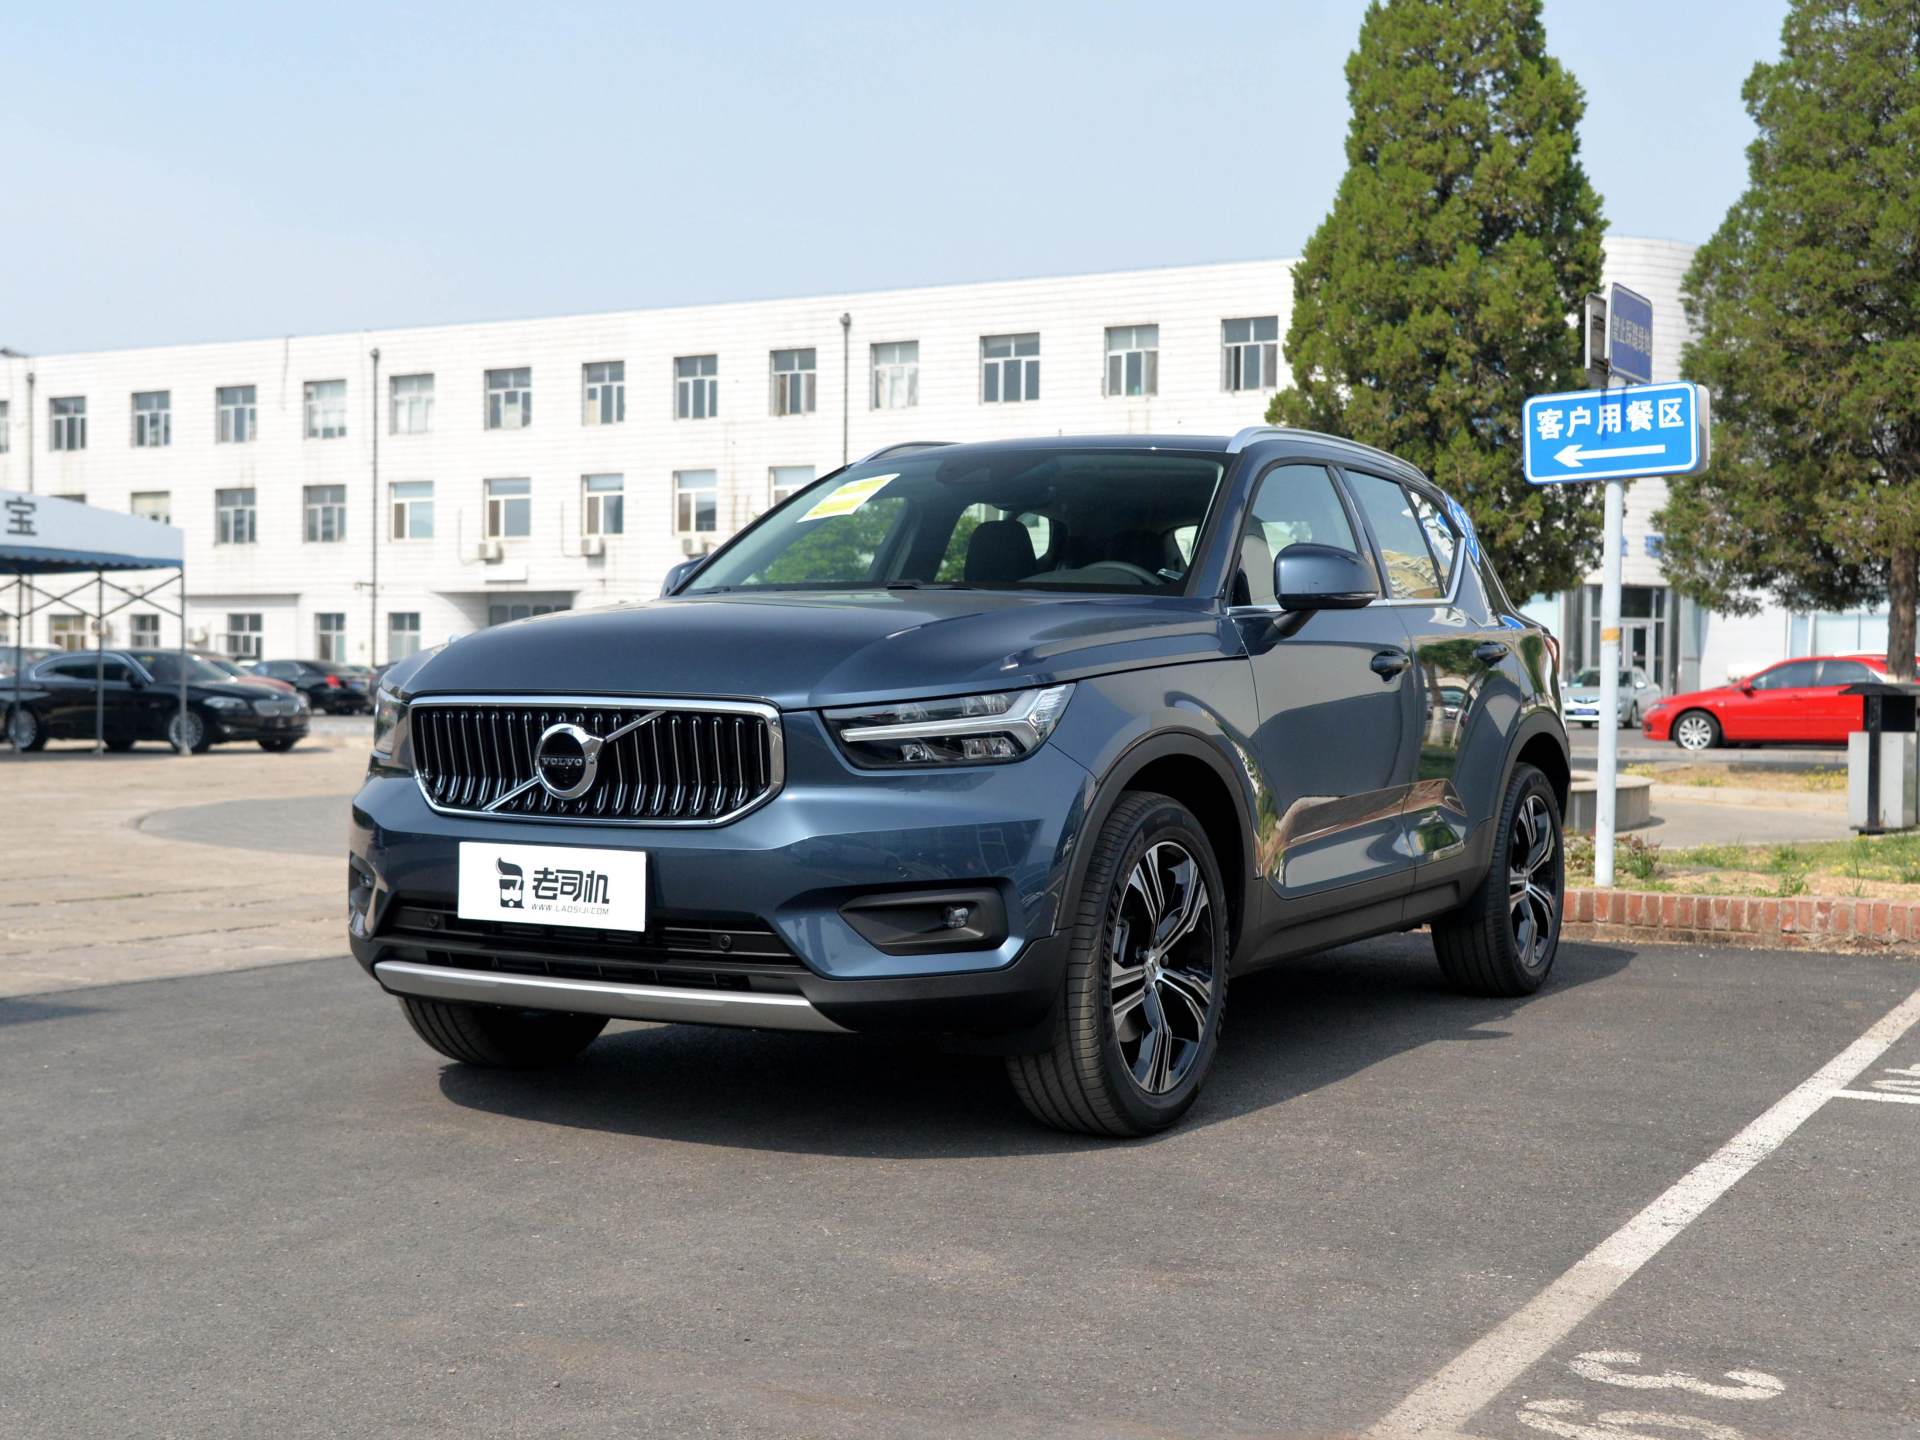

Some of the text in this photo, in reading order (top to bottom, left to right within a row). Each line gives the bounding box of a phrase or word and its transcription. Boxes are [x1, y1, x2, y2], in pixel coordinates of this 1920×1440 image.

[1536, 397, 1685, 441] 客户用餐区
[5, 496, 38, 536] 宝
[542, 757, 583, 767] VOLVO
[532, 867, 610, 905] 老司机
